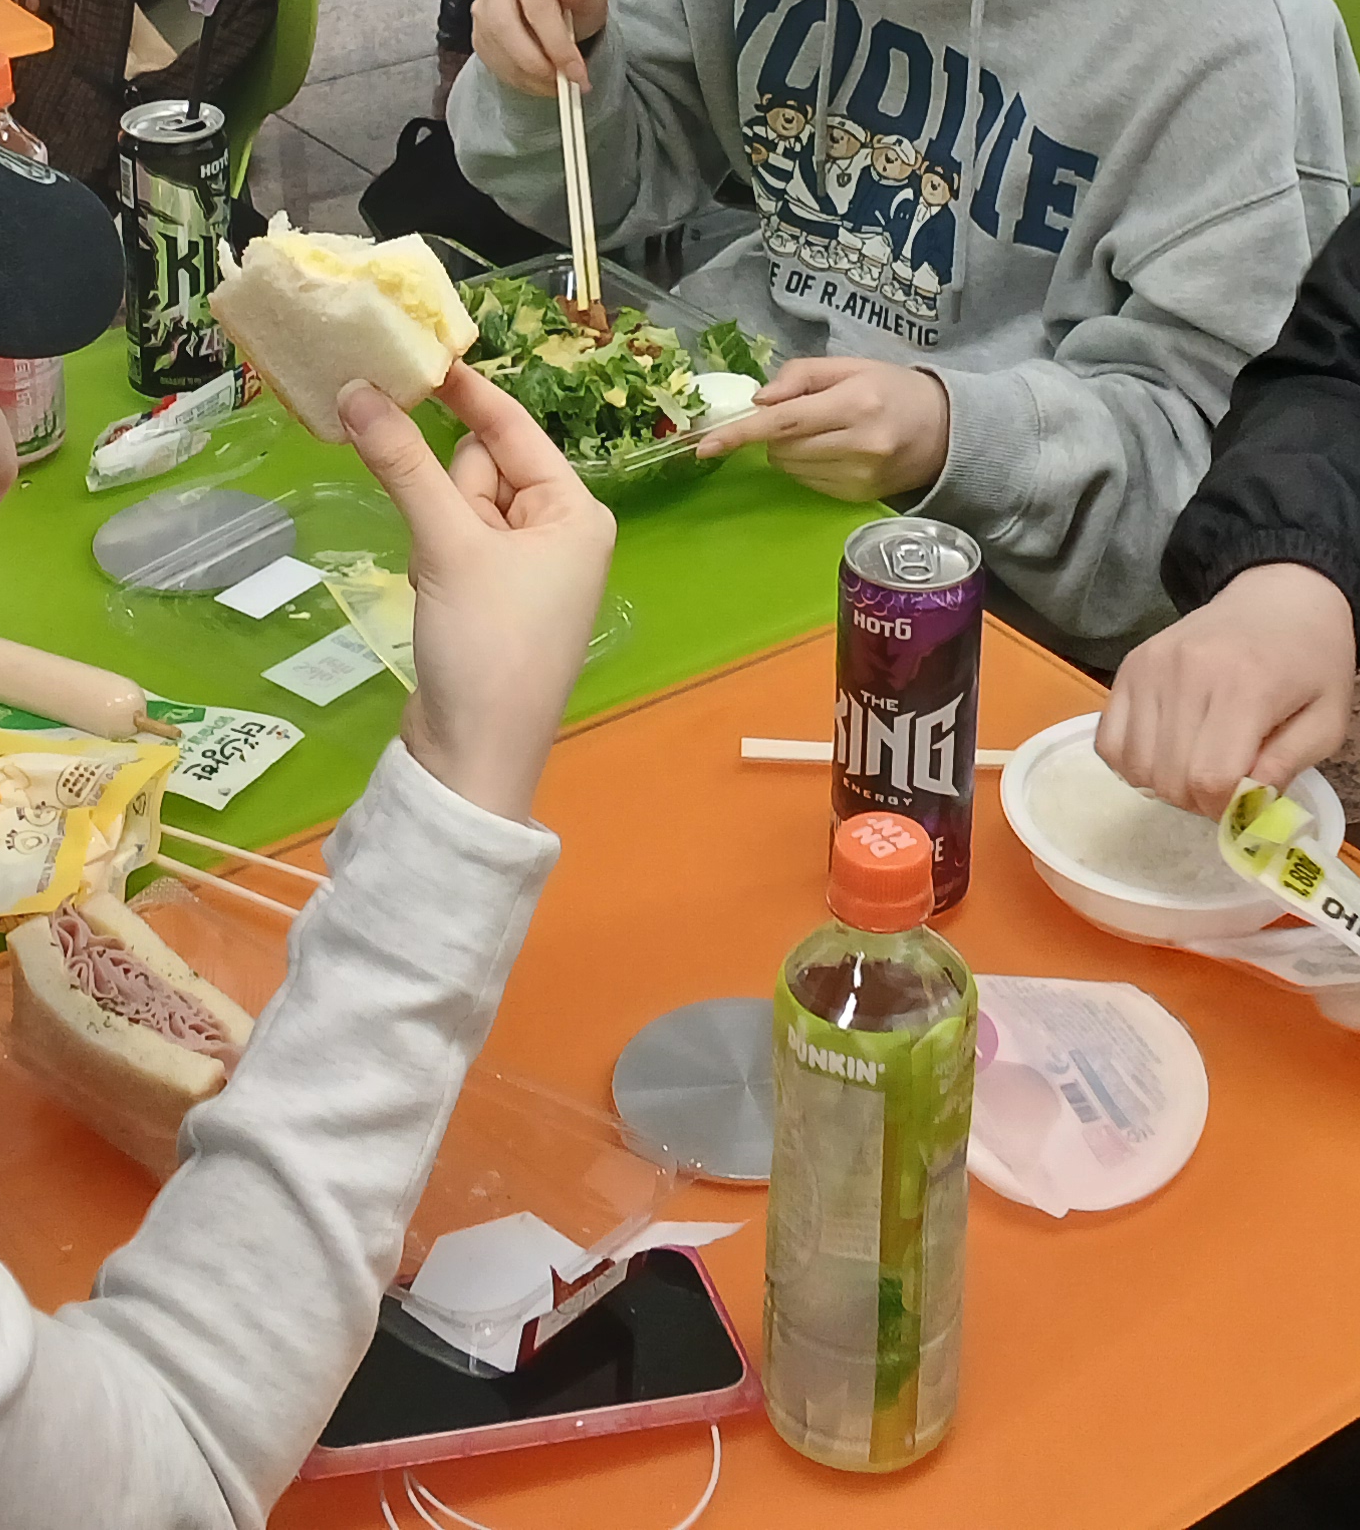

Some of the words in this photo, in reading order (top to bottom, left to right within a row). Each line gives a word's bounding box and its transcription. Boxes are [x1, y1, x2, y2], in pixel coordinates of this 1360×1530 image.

[785, 270, 817, 298] OF
[860, 689, 899, 712] THE
[834, 687, 965, 798] KING
[843, 776, 913, 807] ENERGY
[787, 1023, 886, 1087] DUNKIN'
